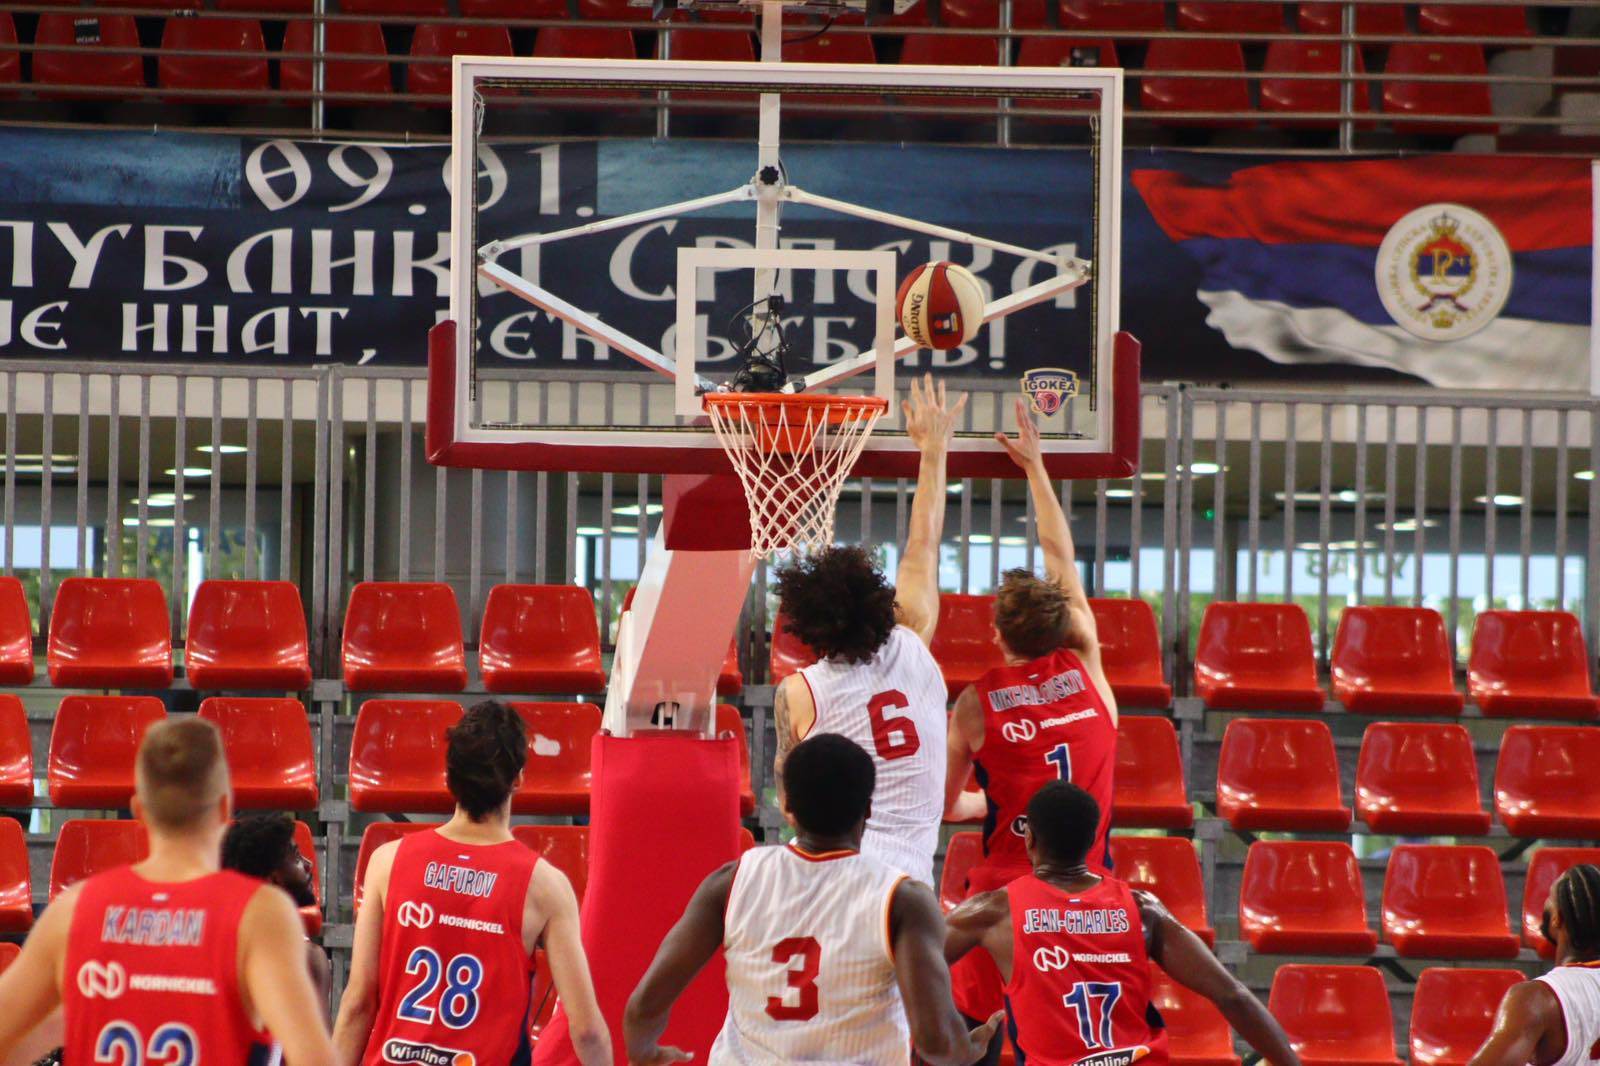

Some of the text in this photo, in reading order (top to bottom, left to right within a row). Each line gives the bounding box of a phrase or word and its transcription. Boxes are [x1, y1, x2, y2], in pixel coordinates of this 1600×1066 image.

[867, 689, 921, 760] 6
[1044, 743, 1072, 784] 1
[424, 861, 498, 898] GAFUROV
[101, 905, 205, 946] KARDAN
[439, 914, 504, 934] NORNICKEL
[1023, 908, 1129, 934] JEAN-CHARLES
[397, 946, 483, 1029] 28
[765, 936, 821, 1021] 3
[1062, 981, 1121, 1049] 17
[390, 1043, 449, 1066] Winline
